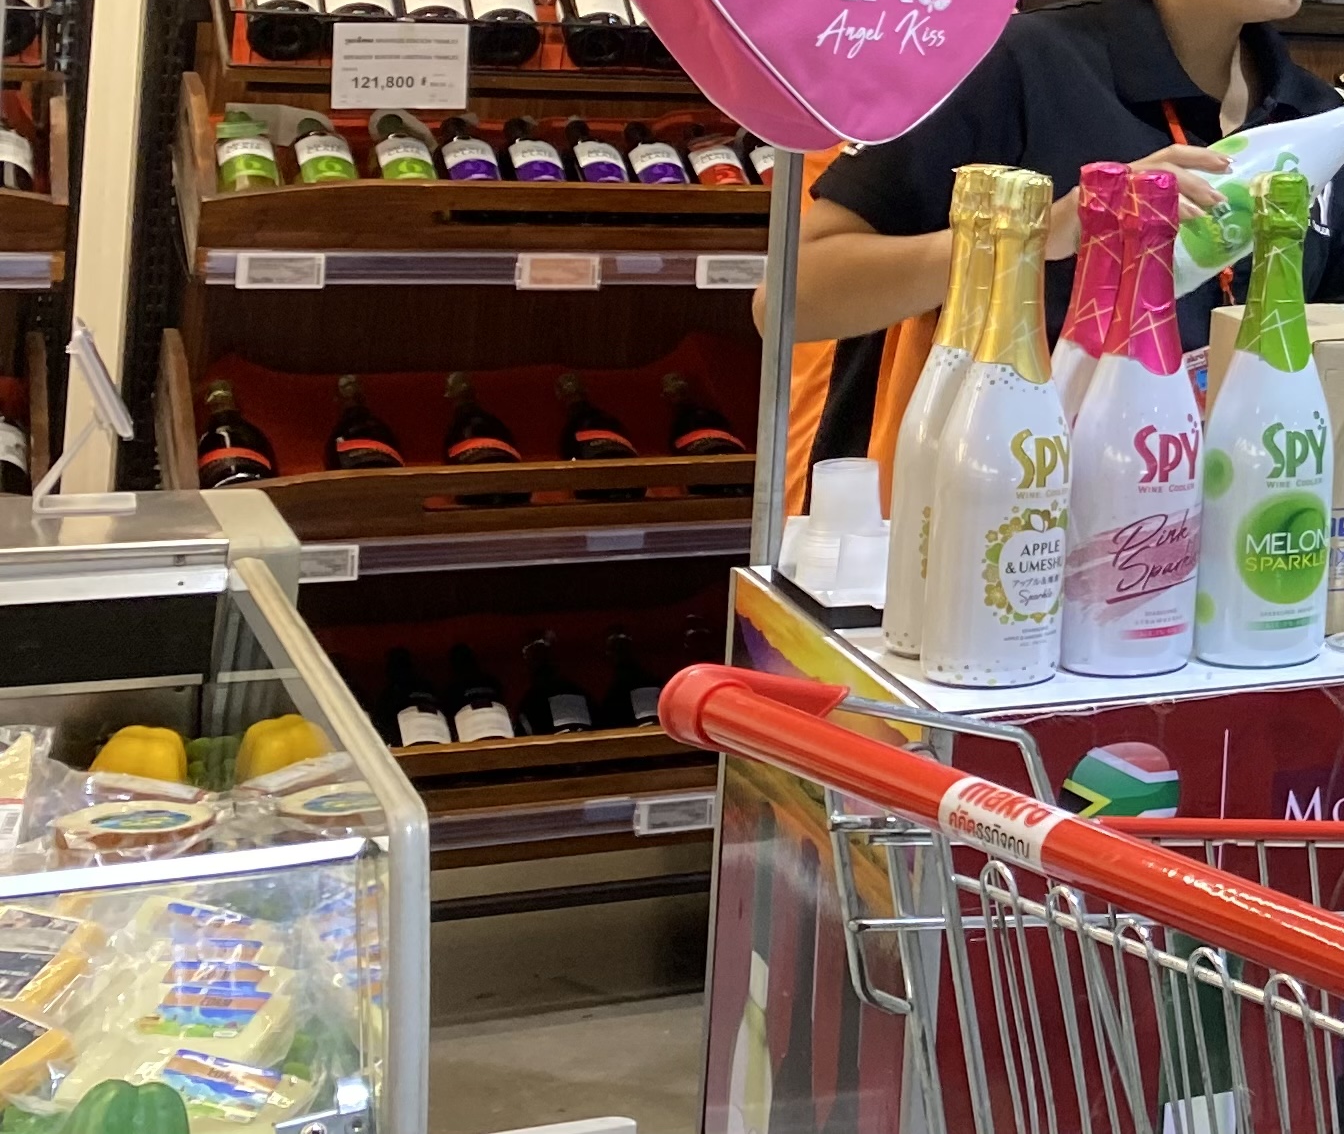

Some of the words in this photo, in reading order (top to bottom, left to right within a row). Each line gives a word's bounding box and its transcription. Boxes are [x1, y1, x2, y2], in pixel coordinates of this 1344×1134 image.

[815, 9, 886, 59] Angel
[895, 9, 946, 56] Kiss
[351, 76, 415, 91] 121,800
[1010, 428, 1070, 490] SPY
[1133, 424, 1199, 484] SPY
[1262, 422, 1327, 479] SPY
[1138, 485, 1163, 494] WINE
[1020, 540, 1061, 557] APPLE
[1108, 508, 1189, 567] Pink
[1246, 528, 1329, 555] MELON
[958, 781, 1054, 828] makro
